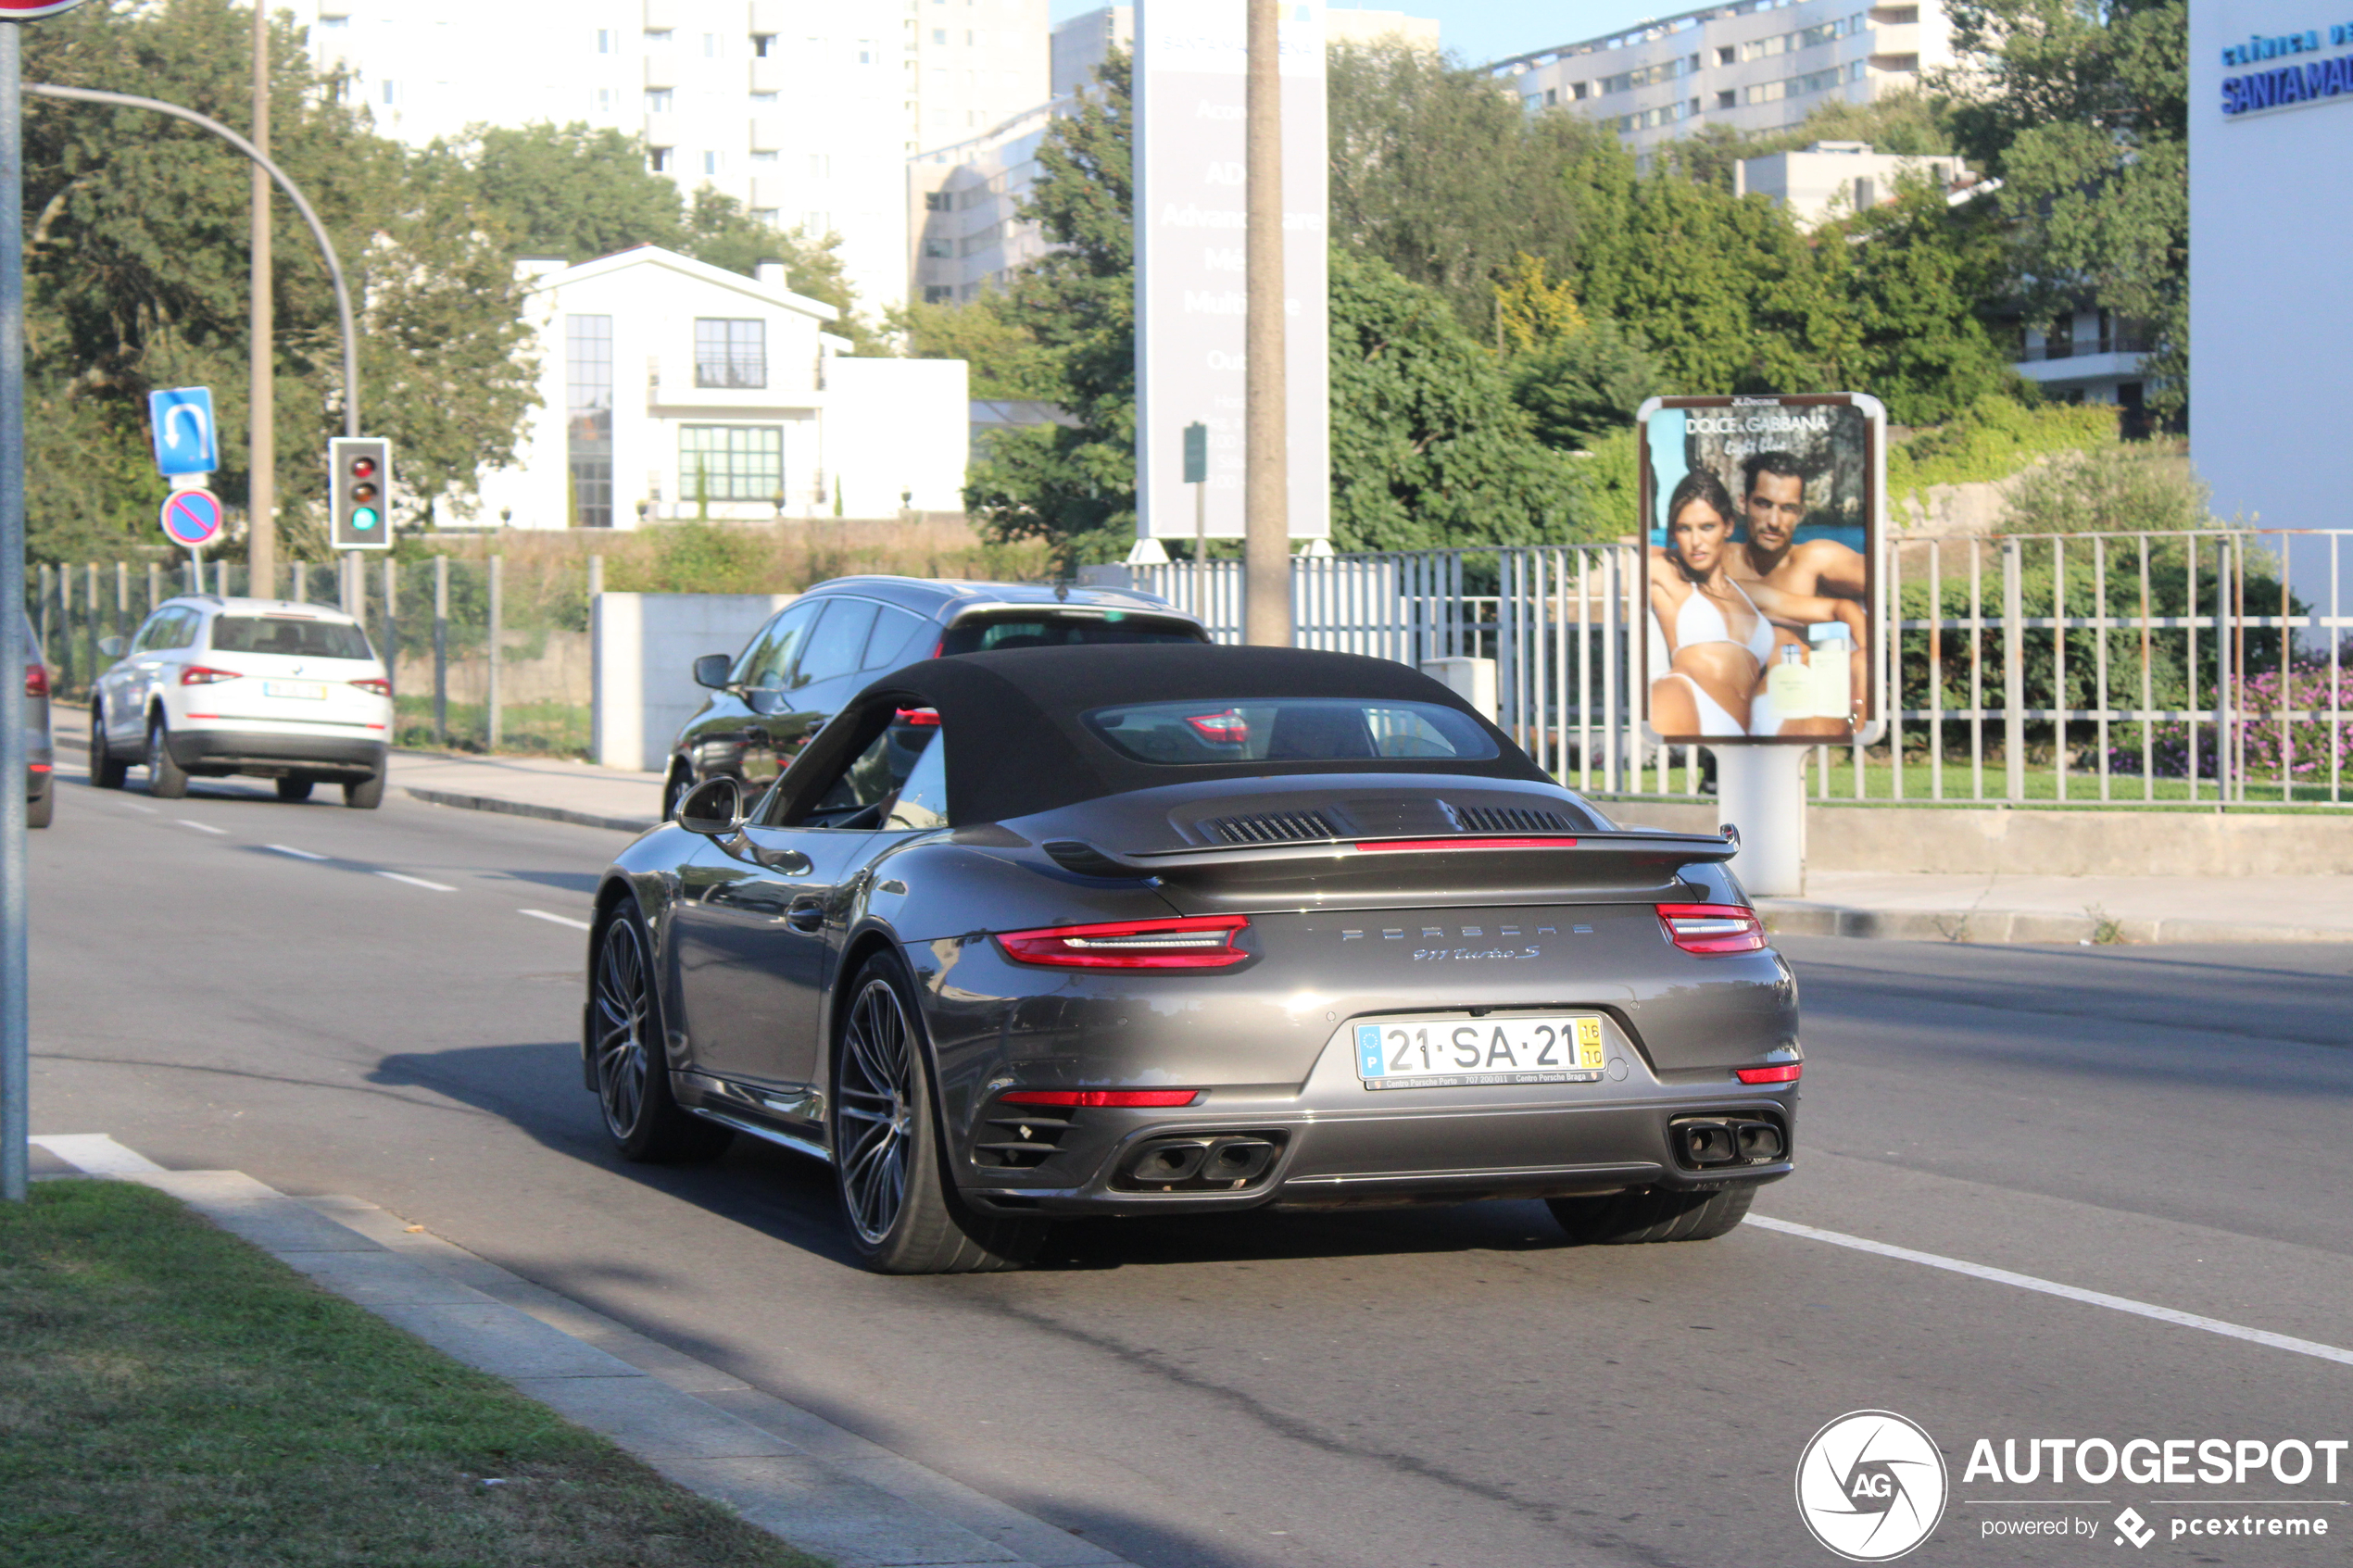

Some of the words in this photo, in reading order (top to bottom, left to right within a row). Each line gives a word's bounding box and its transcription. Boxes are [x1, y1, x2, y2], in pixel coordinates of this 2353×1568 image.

[1222, 39, 1313, 55] MAENA
[2221, 65, 2307, 115] SANTA
[1342, 923, 1593, 940] PORSCHE
[1414, 948, 1448, 960] 911
[1454, 947, 1515, 960] Turbo
[1516, 945, 1540, 959] S
[1581, 1025, 1599, 1038] 16
[1367, 1057, 1377, 1068] P
[1584, 1051, 1602, 1064] 10
[1386, 1079, 1408, 1087] Centro
[1410, 1078, 1437, 1086] Porsche
[1480, 1075, 1493, 1084] 200
[1495, 1074, 1507, 1083] 011
[1516, 1074, 1537, 1083] Centro
[1539, 1073, 1566, 1082] Porsche
[1567, 1073, 1586, 1082] Braga
